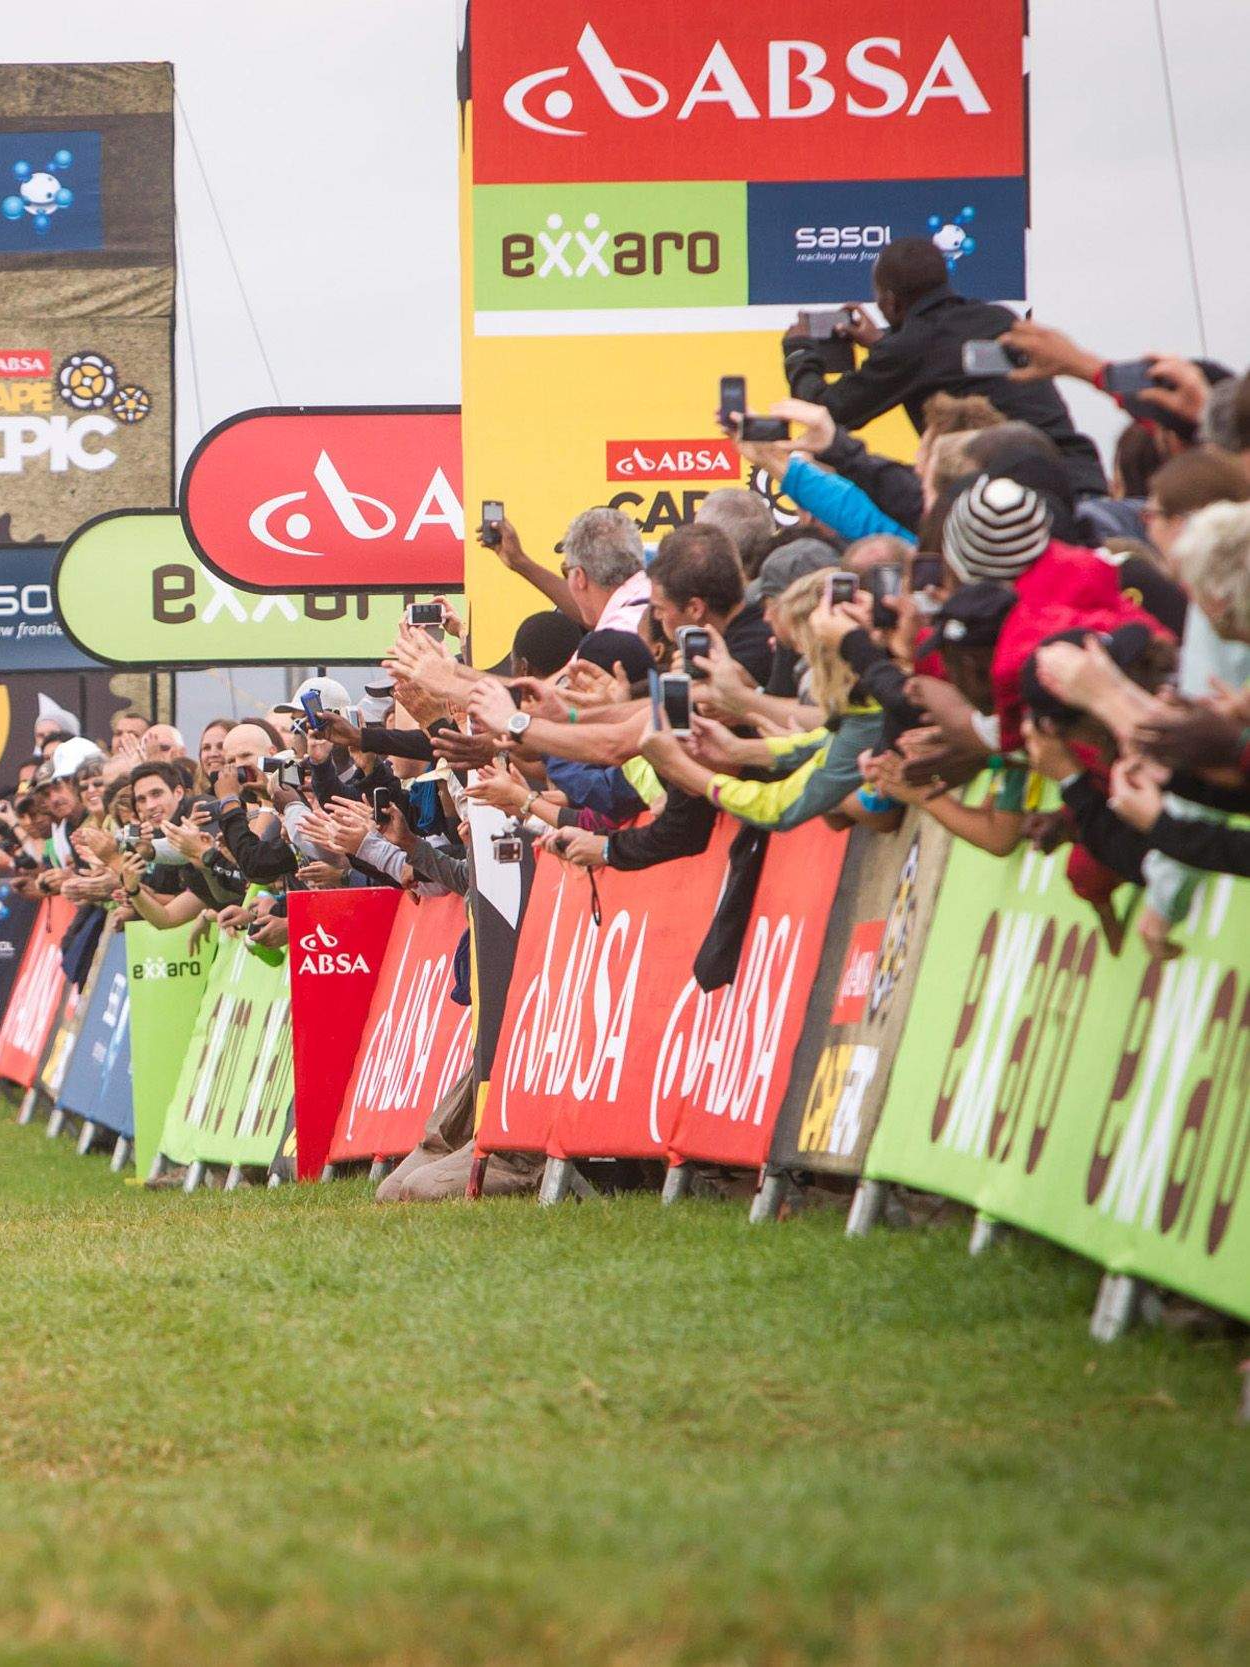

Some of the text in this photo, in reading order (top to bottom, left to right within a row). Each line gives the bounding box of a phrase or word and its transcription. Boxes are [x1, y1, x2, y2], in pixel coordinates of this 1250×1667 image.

[676, 34, 992, 119] ABSA
[502, 222, 719, 278] exxaro
[656, 450, 731, 472] ABSA
[17, 621, 64, 639] frontie
[133, 957, 201, 980] exxaro
[299, 952, 371, 976] ABSA
[533, 910, 648, 1103] ABSA
